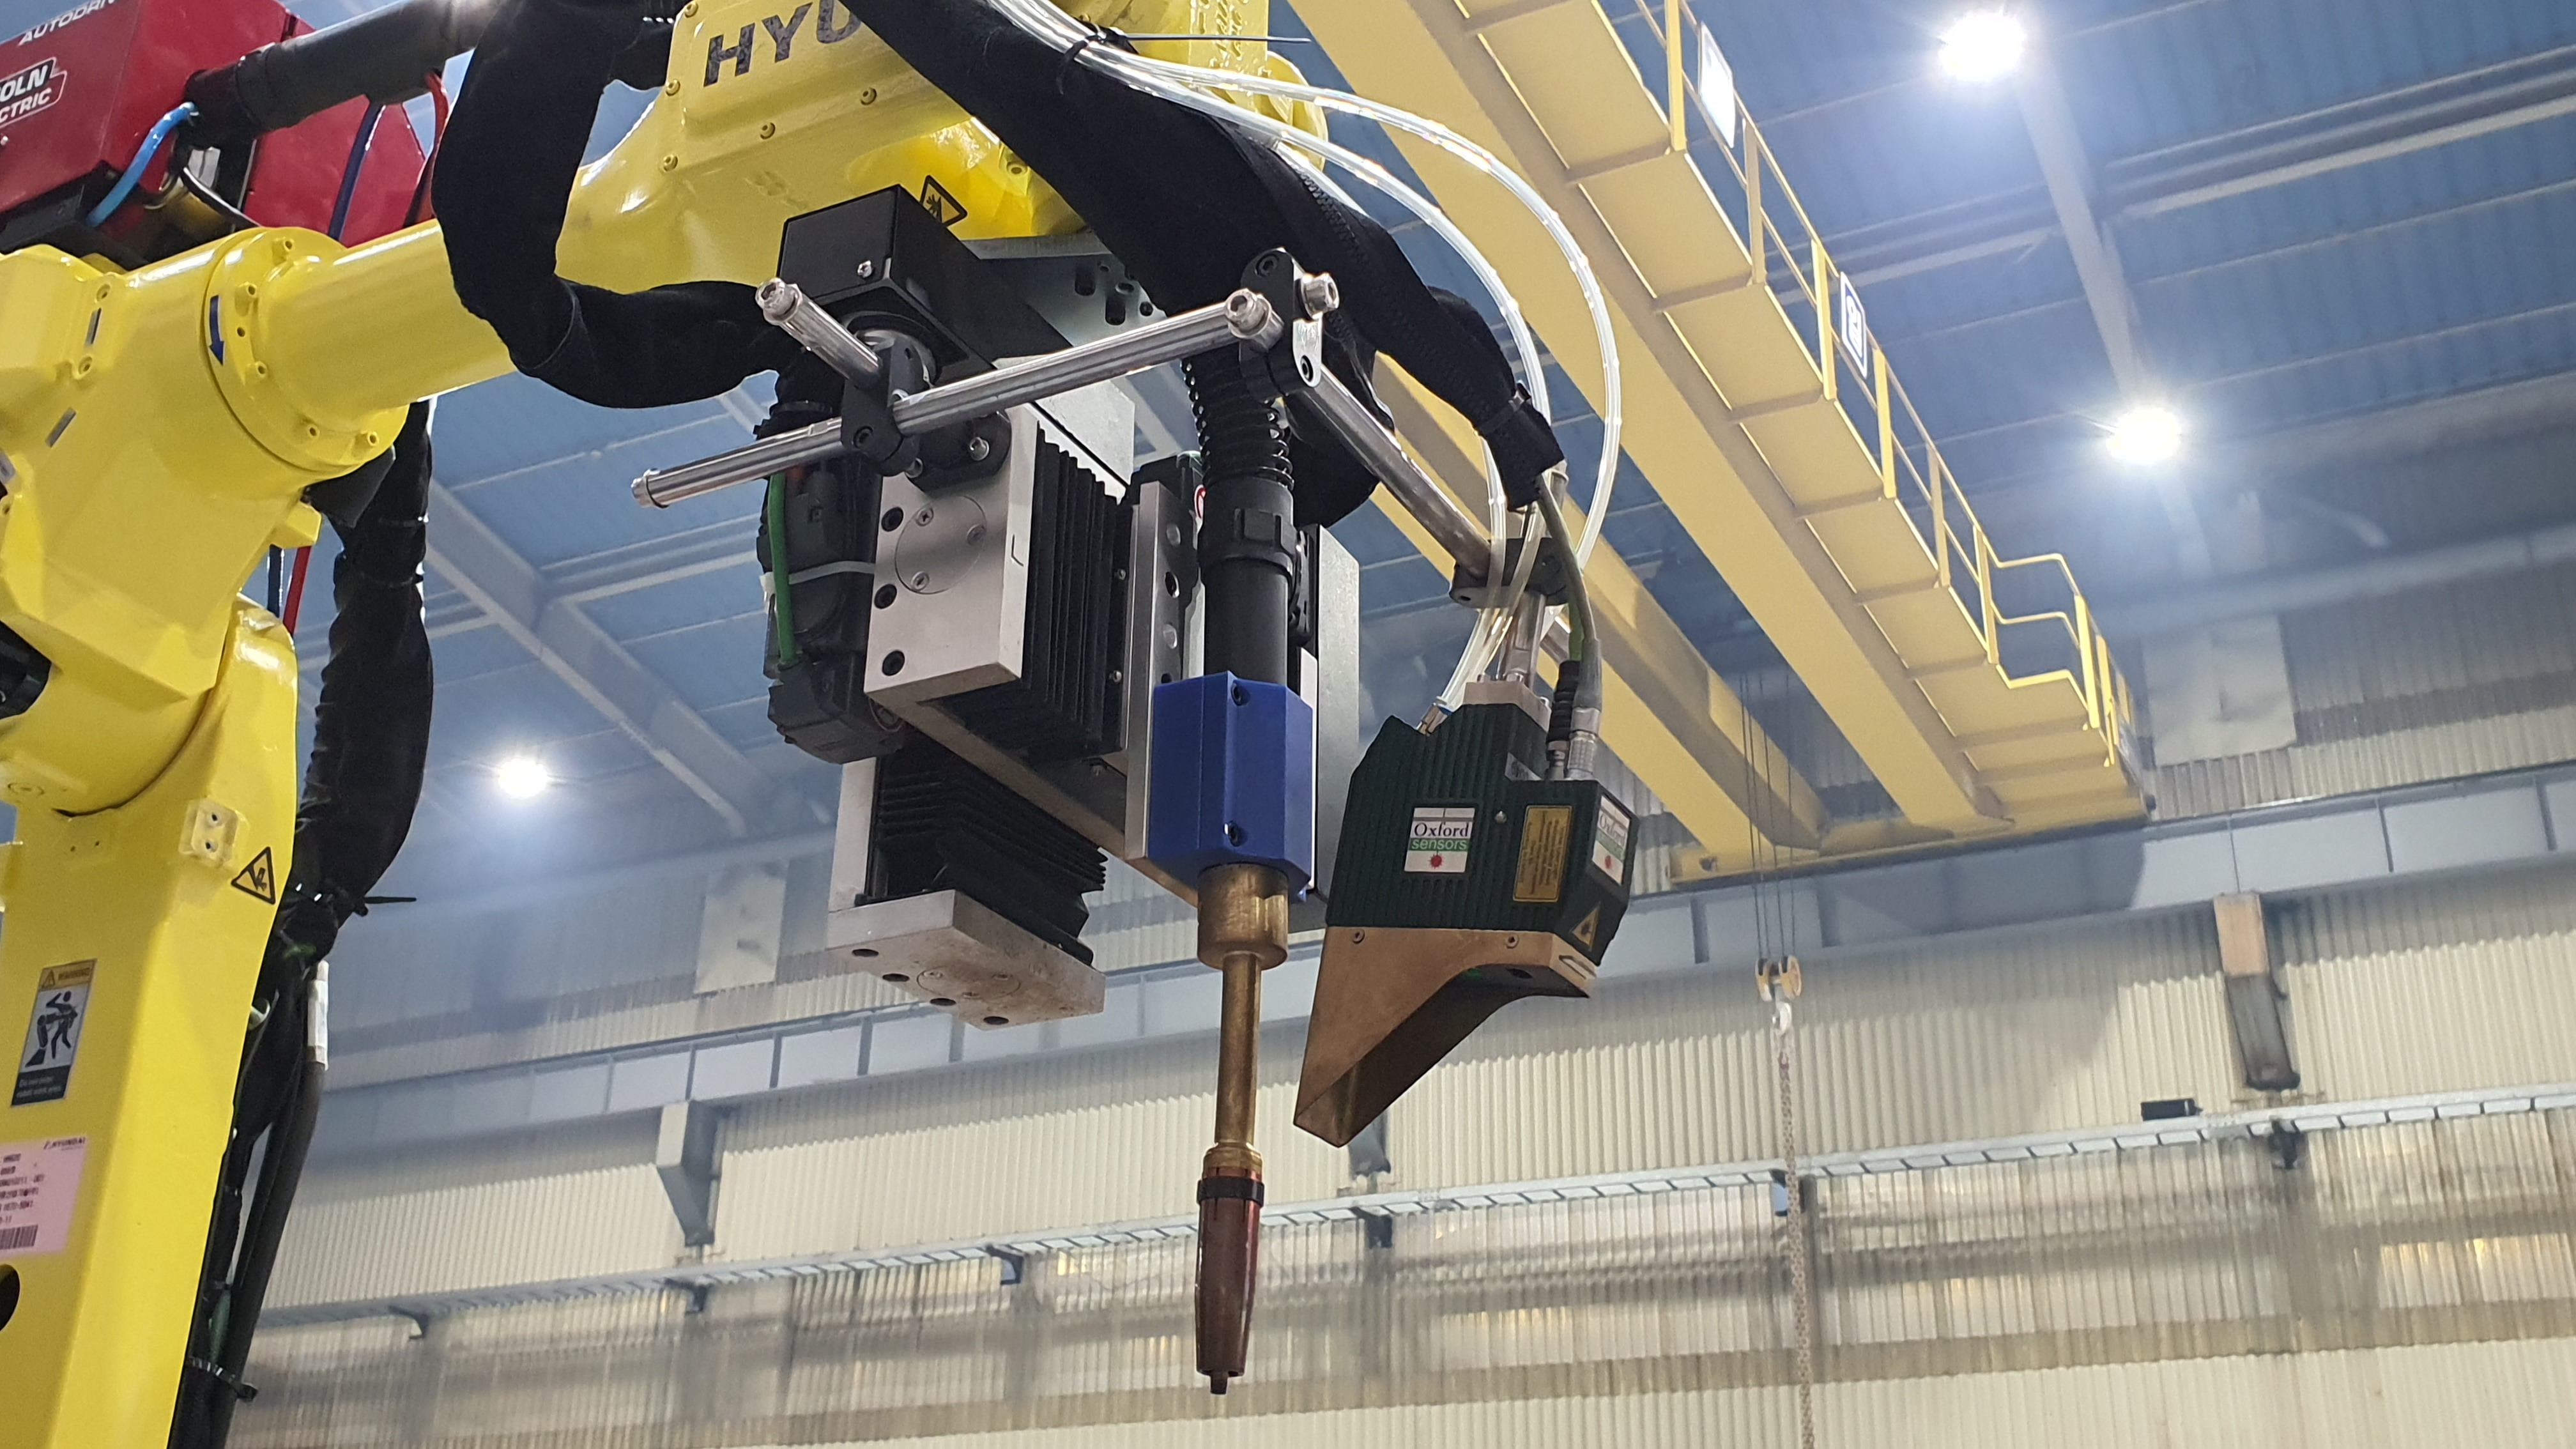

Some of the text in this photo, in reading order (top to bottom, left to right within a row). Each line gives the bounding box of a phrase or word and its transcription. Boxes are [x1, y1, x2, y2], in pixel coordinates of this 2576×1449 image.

[17, 0, 114, 46] AUTODRI
[0, 65, 49, 102] OLN
[1414, 822, 1468, 837] Oxford
[1411, 839, 1468, 850] sensors
